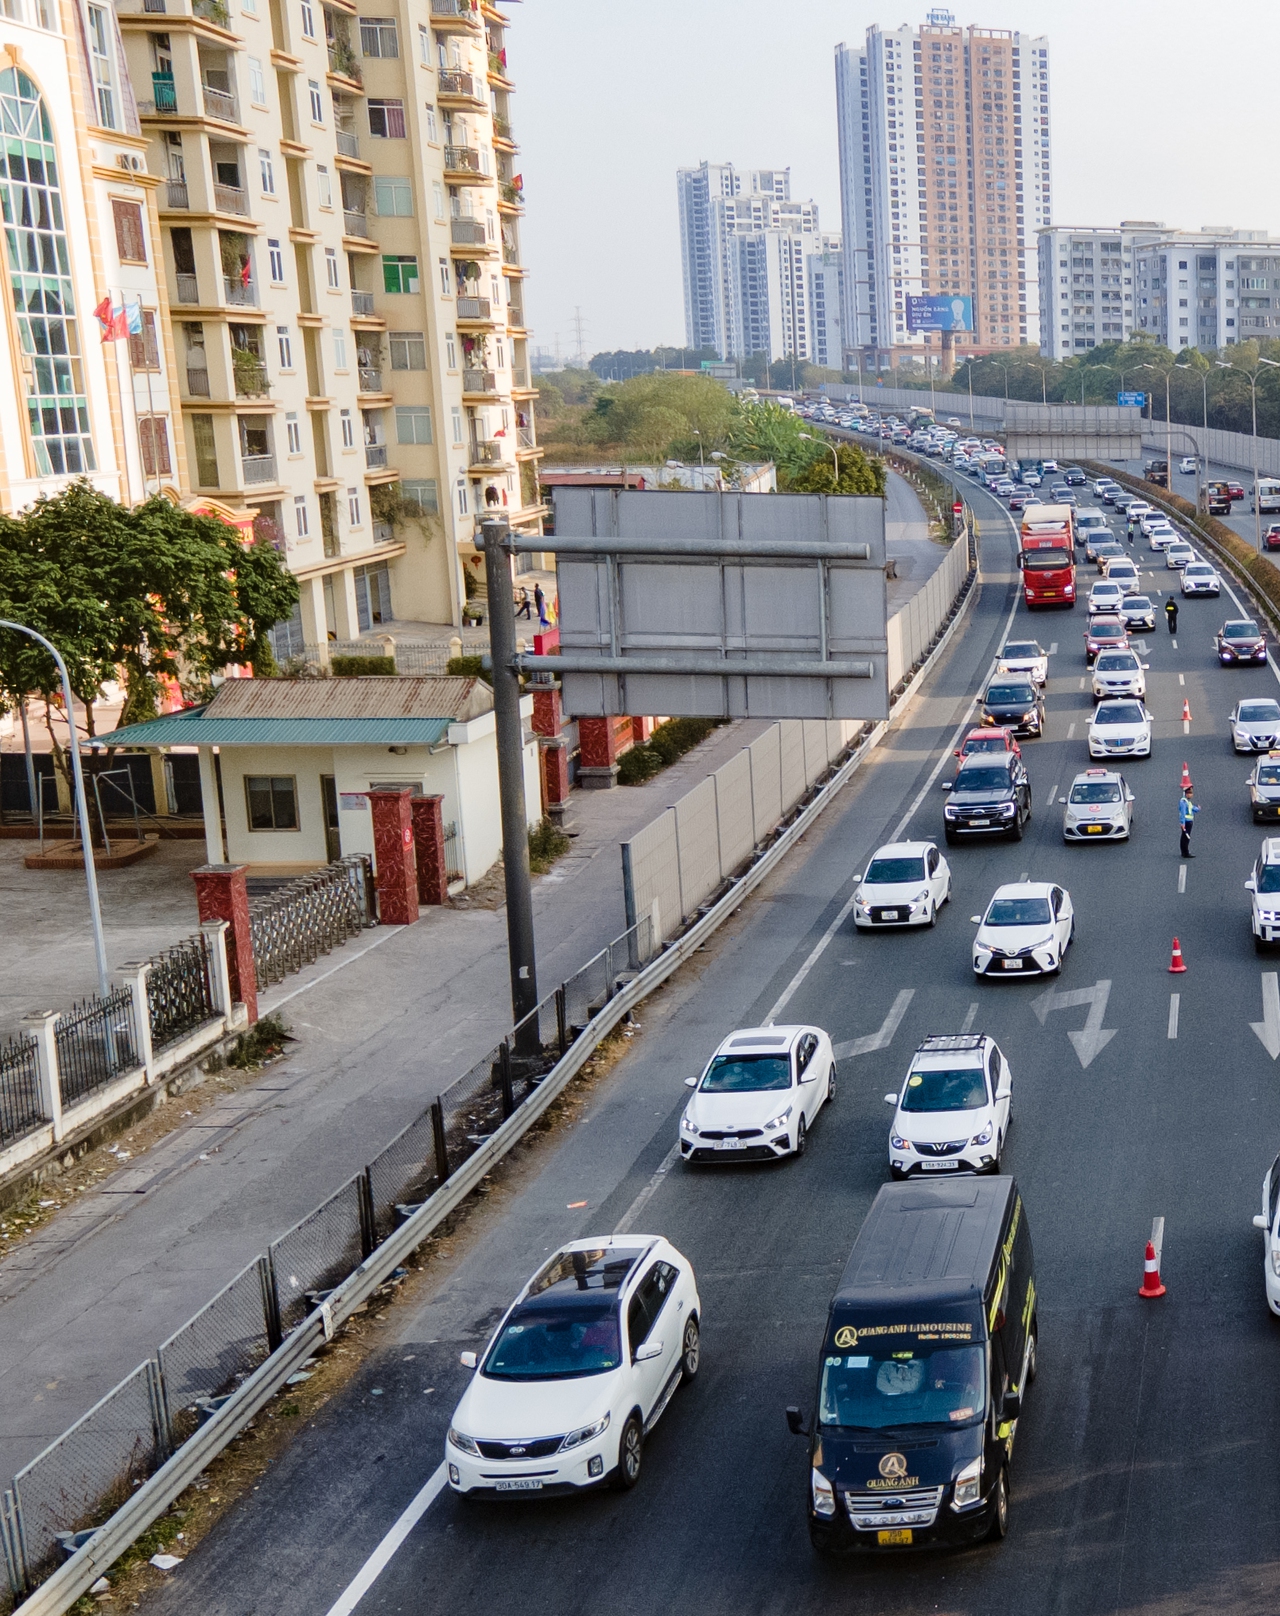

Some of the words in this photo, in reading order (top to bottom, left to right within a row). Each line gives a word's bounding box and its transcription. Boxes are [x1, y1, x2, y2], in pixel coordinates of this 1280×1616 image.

[909, 1323, 973, 1333] LIMOUSINE
[866, 1478, 899, 1489] QUANG
[899, 1476, 920, 1487] ANH
